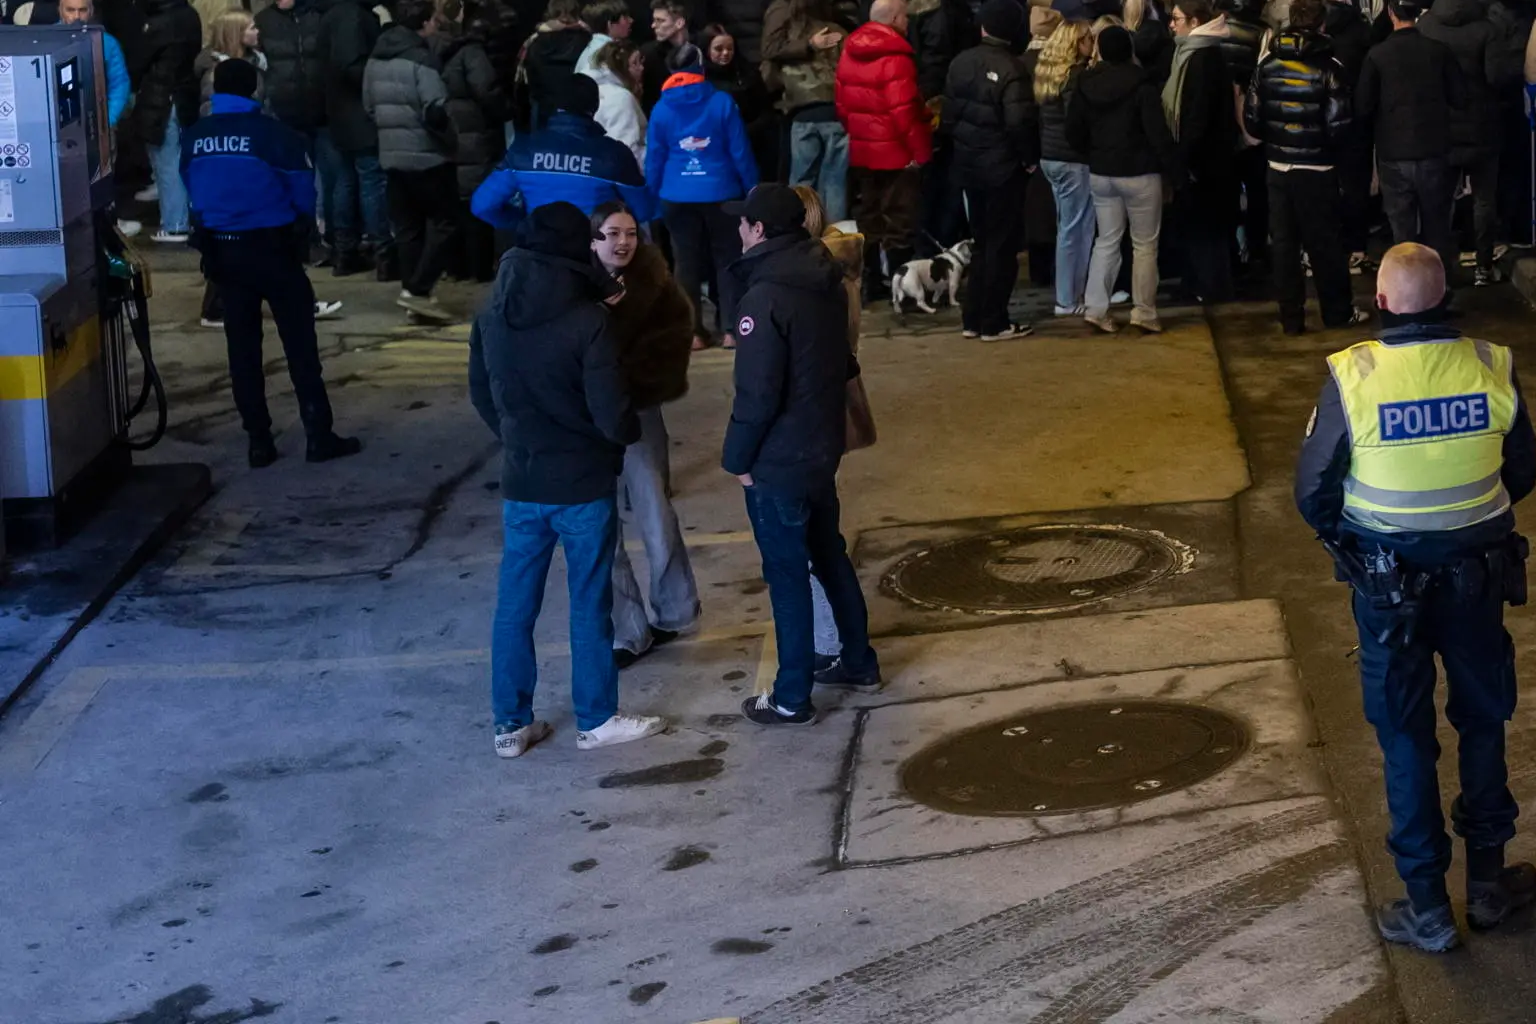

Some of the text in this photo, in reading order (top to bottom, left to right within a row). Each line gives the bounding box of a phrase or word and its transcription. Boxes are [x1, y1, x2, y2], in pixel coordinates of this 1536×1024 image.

[31, 57, 41, 79] 1
[193, 136, 251, 154] POLICE
[533, 152, 593, 174] POLICE
[1383, 397, 1486, 437] POLICE
